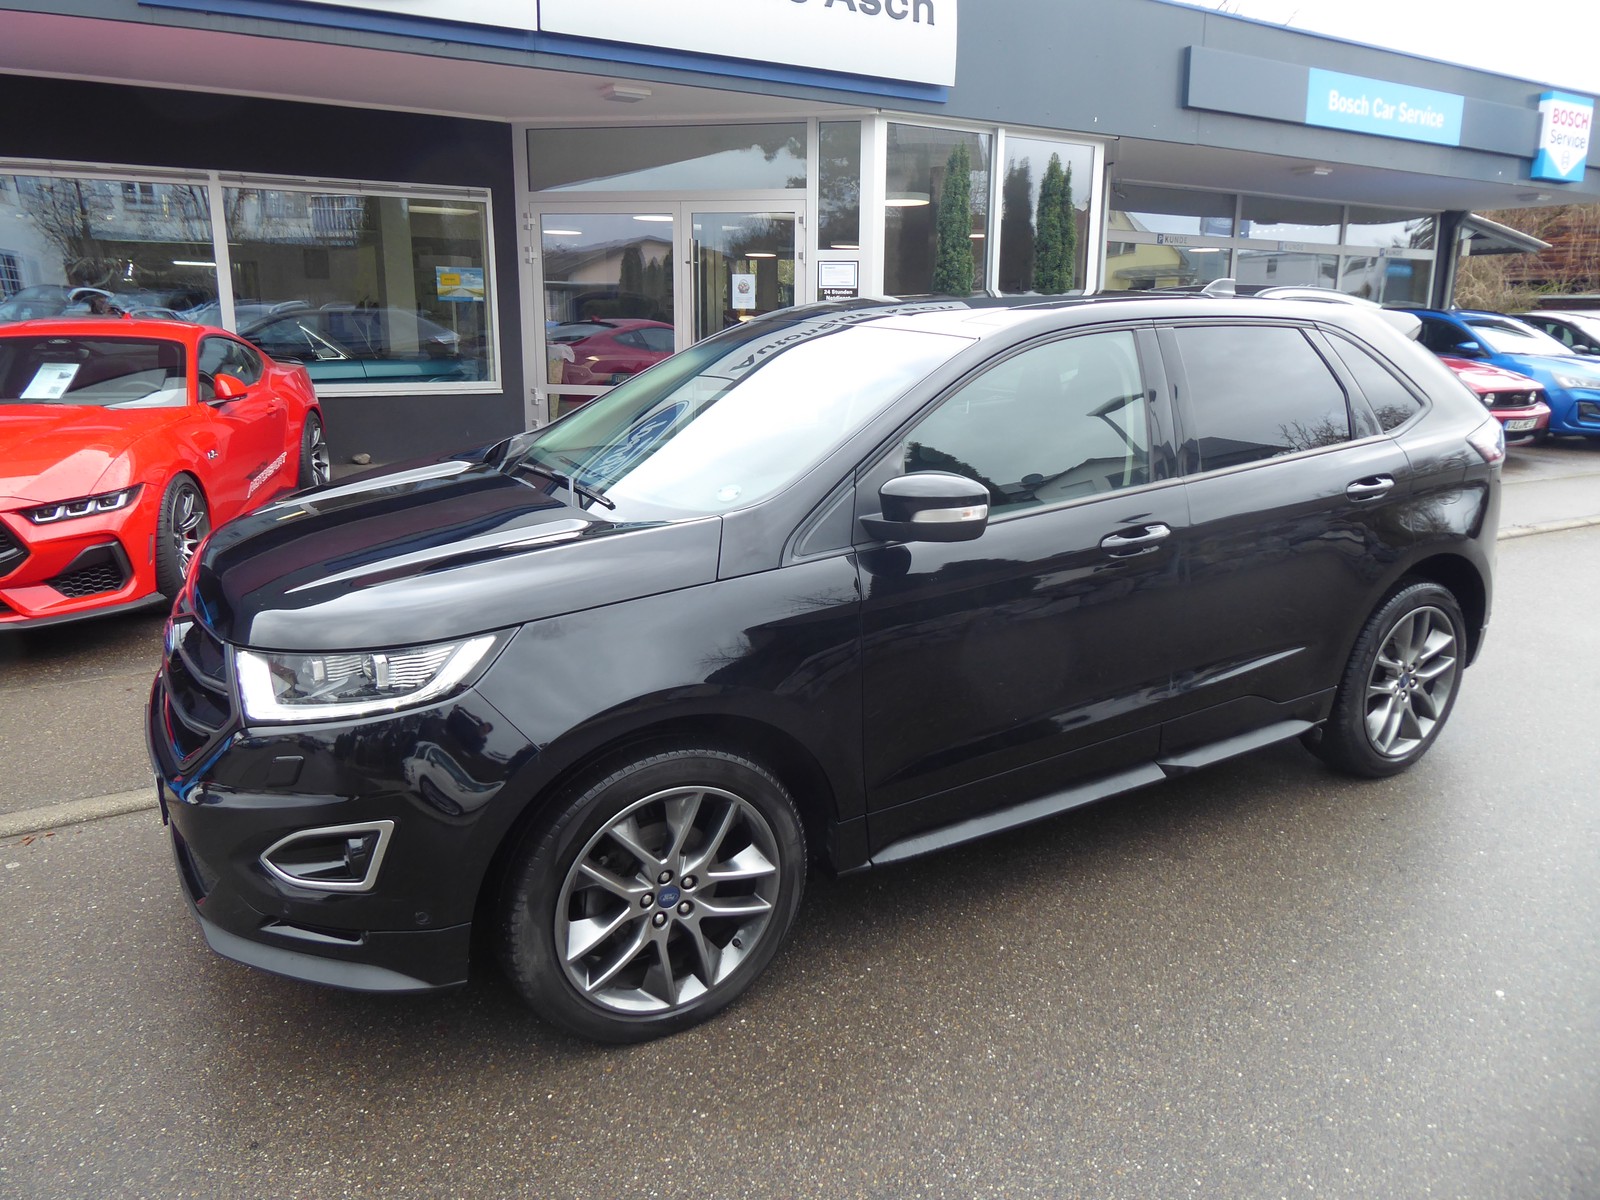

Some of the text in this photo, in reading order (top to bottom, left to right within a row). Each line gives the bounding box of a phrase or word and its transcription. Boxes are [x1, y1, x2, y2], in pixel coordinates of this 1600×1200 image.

[1328, 89, 1444, 128] Bosch Car Service
[1552, 107, 1590, 130] BOSCH
[1550, 129, 1586, 149] Service
[1165, 235, 1188, 244] KUNDE
